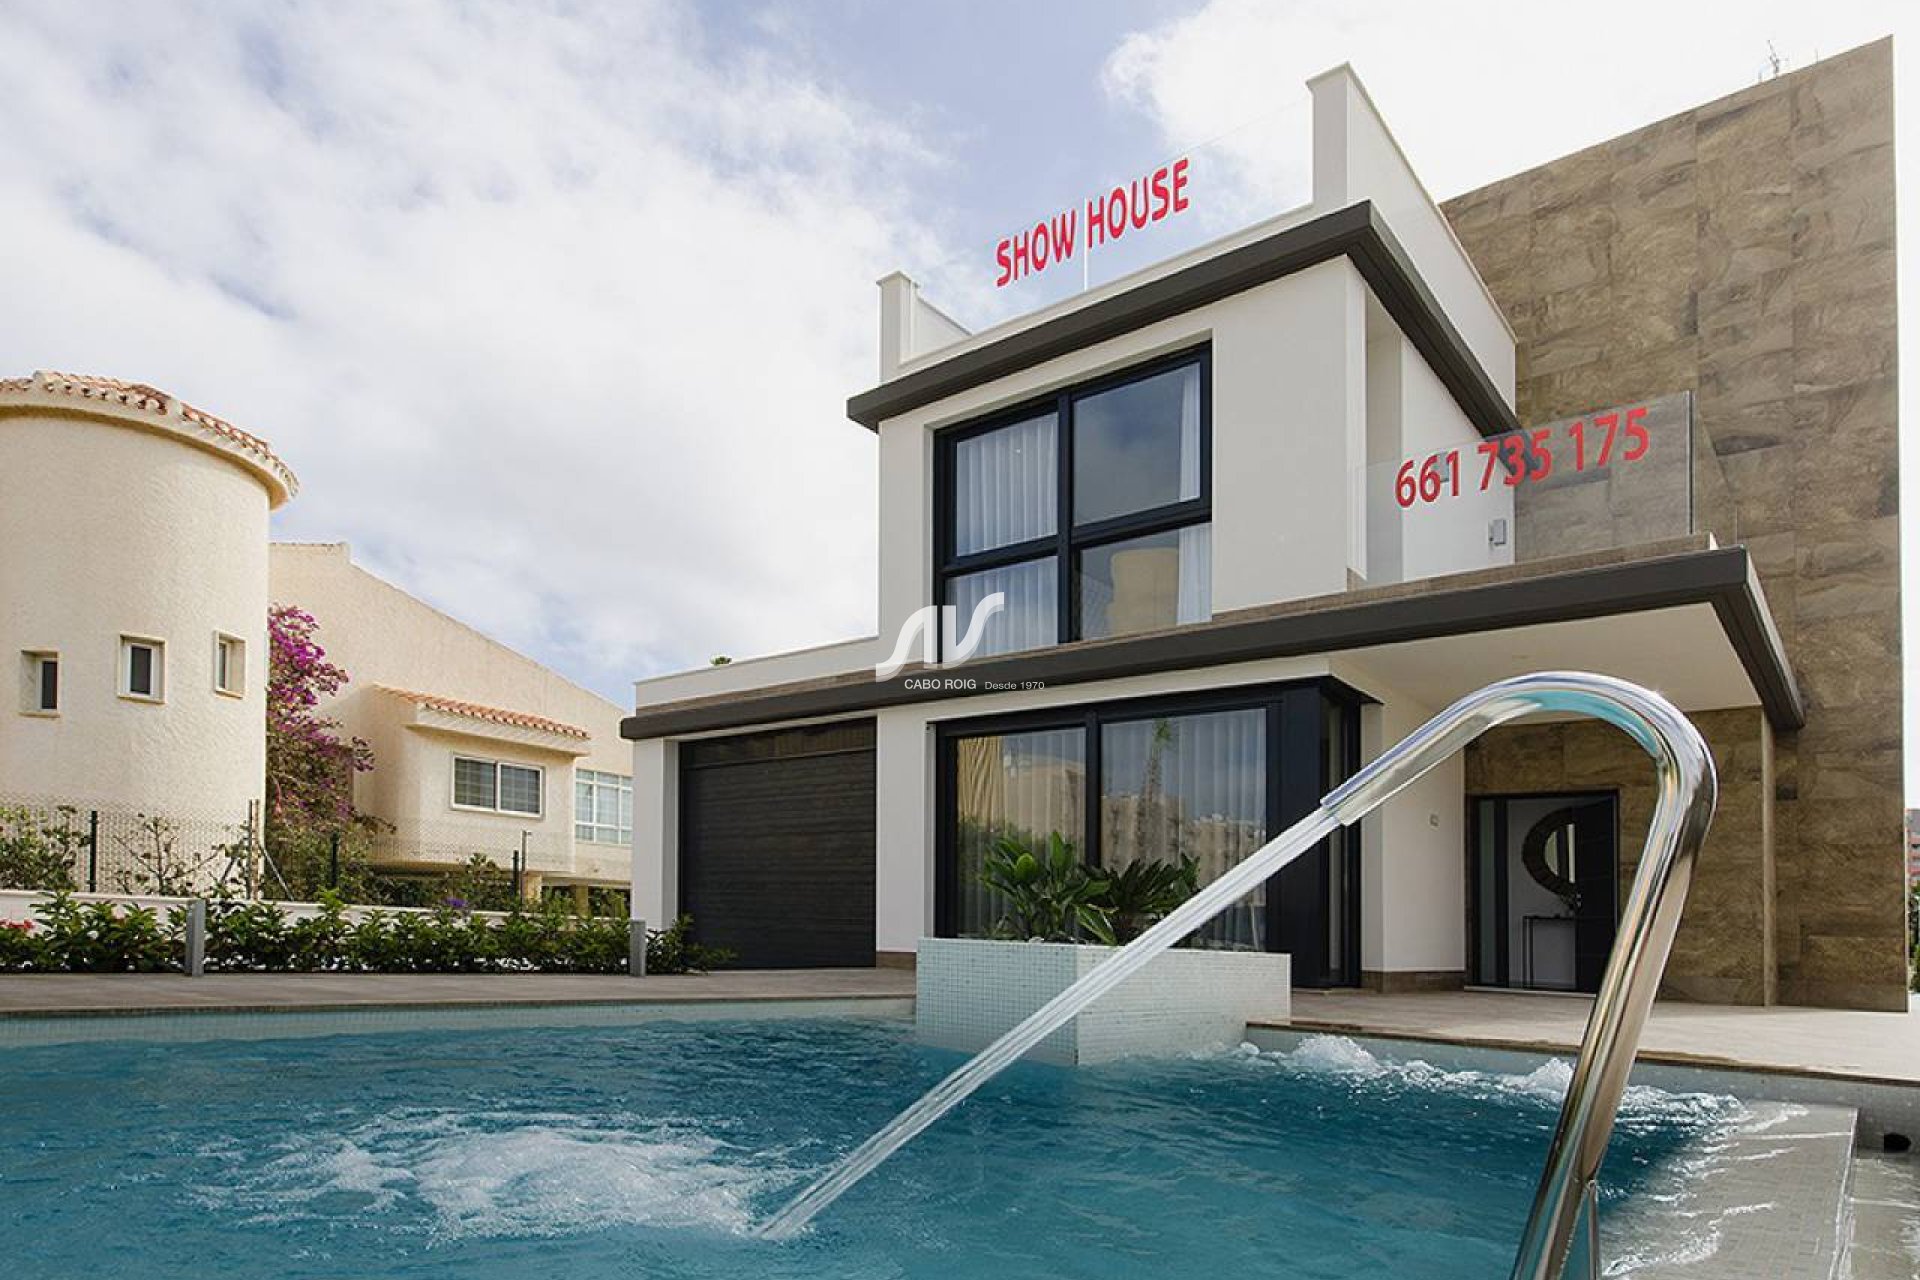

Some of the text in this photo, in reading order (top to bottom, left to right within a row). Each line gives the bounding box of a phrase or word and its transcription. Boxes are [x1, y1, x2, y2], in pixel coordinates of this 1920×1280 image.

[996, 157, 1190, 287] SHOW HOUSE
[1395, 406, 1650, 509] 661 735 175
